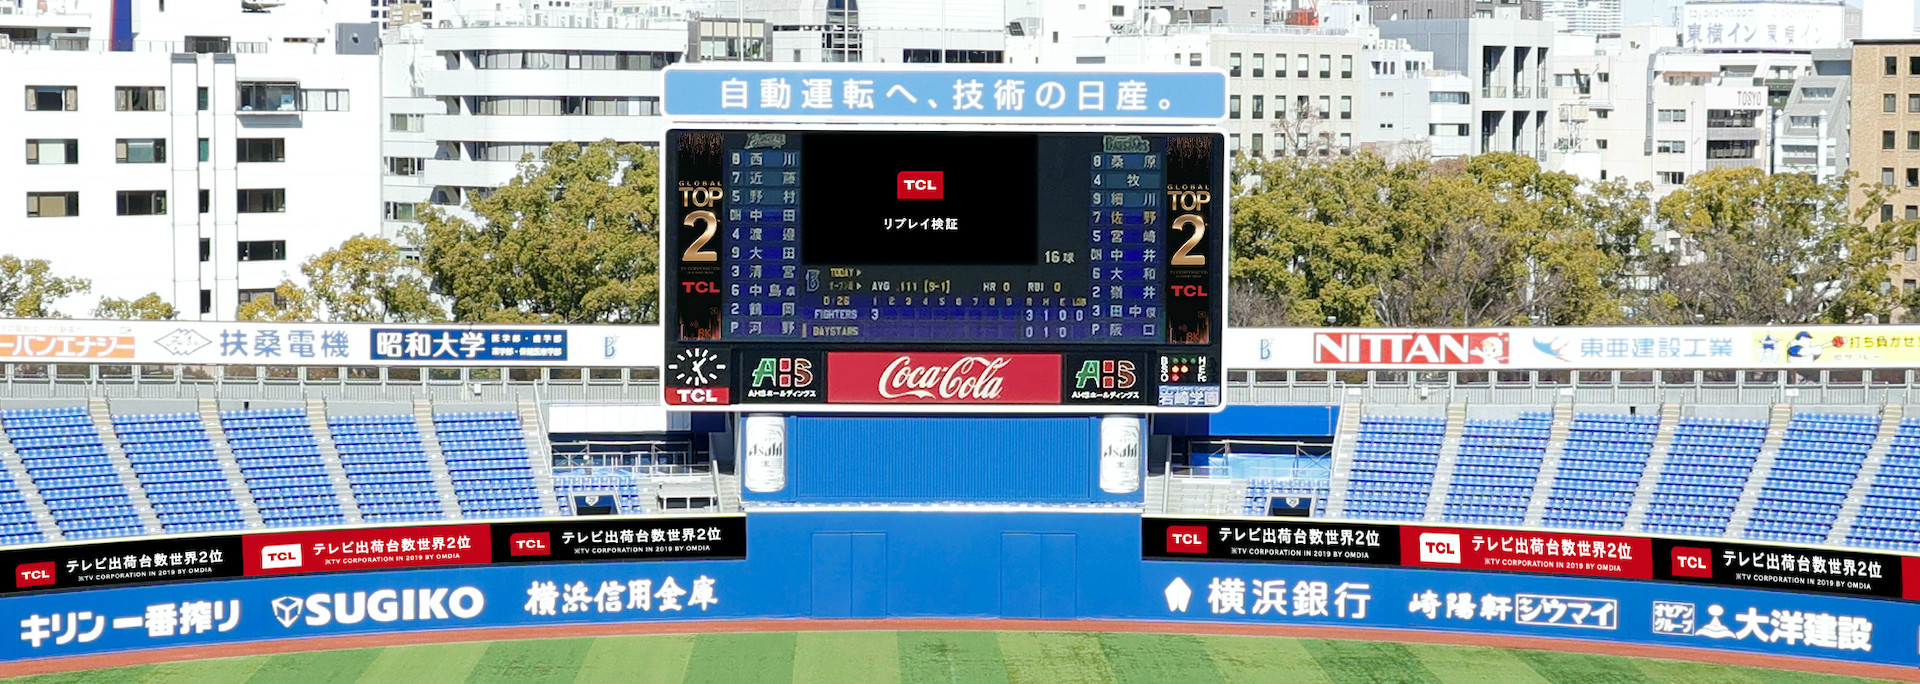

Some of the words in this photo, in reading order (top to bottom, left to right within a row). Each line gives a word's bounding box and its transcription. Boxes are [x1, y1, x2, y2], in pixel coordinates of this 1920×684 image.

[1686, 23, 1758, 44] 東横イン
[720, 78, 1171, 111] 自動運転へ、技術の日産。
[1737, 91, 1762, 105] TOSYO
[731, 153, 740, 165] 8
[1093, 156, 1101, 168] 8
[731, 171, 740, 184] 7
[1093, 175, 1101, 186] 4
[904, 180, 936, 190] TCL
[678, 187, 723, 207] TOP
[731, 190, 740, 202] 5
[1093, 193, 1101, 205] 9
[1167, 191, 1211, 211] TOP
[884, 217, 958, 230] リプレイ検証
[1093, 212, 1101, 224] 7
[682, 210, 718, 262] 2
[731, 228, 740, 240] 4
[1093, 230, 1101, 242] 5
[1170, 214, 1206, 265] 2
[731, 247, 740, 259] 9
[731, 265, 740, 277] 3
[1092, 268, 1101, 279] 6
[682, 281, 720, 293] TCL
[731, 284, 740, 296] 6
[872, 282, 890, 290] AVG
[983, 282, 997, 292] HR
[1092, 286, 1101, 298] 2
[1171, 285, 1207, 296] TCL
[731, 302, 739, 315] 2
[814, 309, 858, 320] FIGHTERS
[871, 309, 879, 320] 3
[1026, 309, 1033, 321] 3
[1044, 310, 1048, 321] 1
[1059, 310, 1067, 321] 0
[1076, 309, 1083, 321] 0
[1092, 305, 1101, 316] 3
[731, 321, 739, 333] P
[1026, 326, 1033, 337] 0
[1044, 327, 1048, 337] 1
[1059, 327, 1067, 338] 0
[1092, 323, 1101, 335] P
[220, 329, 350, 358] 扶桑電機
[376, 331, 486, 359] 昭和大学
[1315, 334, 1469, 363] NITTAN
[1580, 337, 1733, 358] 東亜建設工業
[878, 356, 1011, 400] Coca-Cola
[677, 389, 718, 402] TCL
[749, 442, 782, 457] Asahi
[1104, 443, 1137, 458] Asahi
[561, 527, 722, 545] テレビ出荷台数世界2位
[1172, 533, 1202, 545] TCL
[1219, 527, 1381, 547] テレビ出荷台数世界2位
[313, 534, 471, 556] テレビ出荷台数世界2位
[516, 539, 545, 549] TCL
[592, 546, 643, 554] CORPORATION
[686, 544, 710, 552] OMDIA
[1425, 541, 1455, 555] TCL
[1472, 534, 1632, 560] テレビ出荷台数世界2位
[268, 552, 296, 562] TCL
[342, 554, 394, 565] CORPORATION
[1249, 547, 1302, 557] CORPORATION
[1303, 549, 1312, 557] IN
[1313, 550, 1331, 558] 2019
[1344, 551, 1369, 559] OMDIA
[65, 548, 224, 573] テレビ出荷台数世界2位
[1501, 558, 1554, 568] CORPORATION
[1566, 562, 1584, 570] 2019
[1585, 563, 1595, 571] BY
[1597, 564, 1622, 572] OMDIA
[1677, 556, 1707, 569] TCL
[1722, 550, 1883, 579] テレビ出荷台数世界2位
[21, 571, 50, 580] TCL
[95, 572, 147, 581] CORPORATION
[188, 567, 213, 575] OMDIA
[1753, 573, 1805, 584] CORPORATION
[1817, 578, 1834, 586] 2019
[1836, 580, 1845, 588] BY
[1847, 581, 1872, 590] OMDIA
[524, 574, 718, 616] 横浜信用金庫
[1207, 577, 1372, 619] 横浜銀行
[305, 586, 485, 627] SUGIKO
[1408, 589, 1514, 621] 崎陽軒
[1518, 597, 1614, 626] シウマイ
[1654, 604, 1693, 618] オセアン
[1654, 618, 1693, 633] グループ
[1735, 607, 1873, 652] 大洋建設
